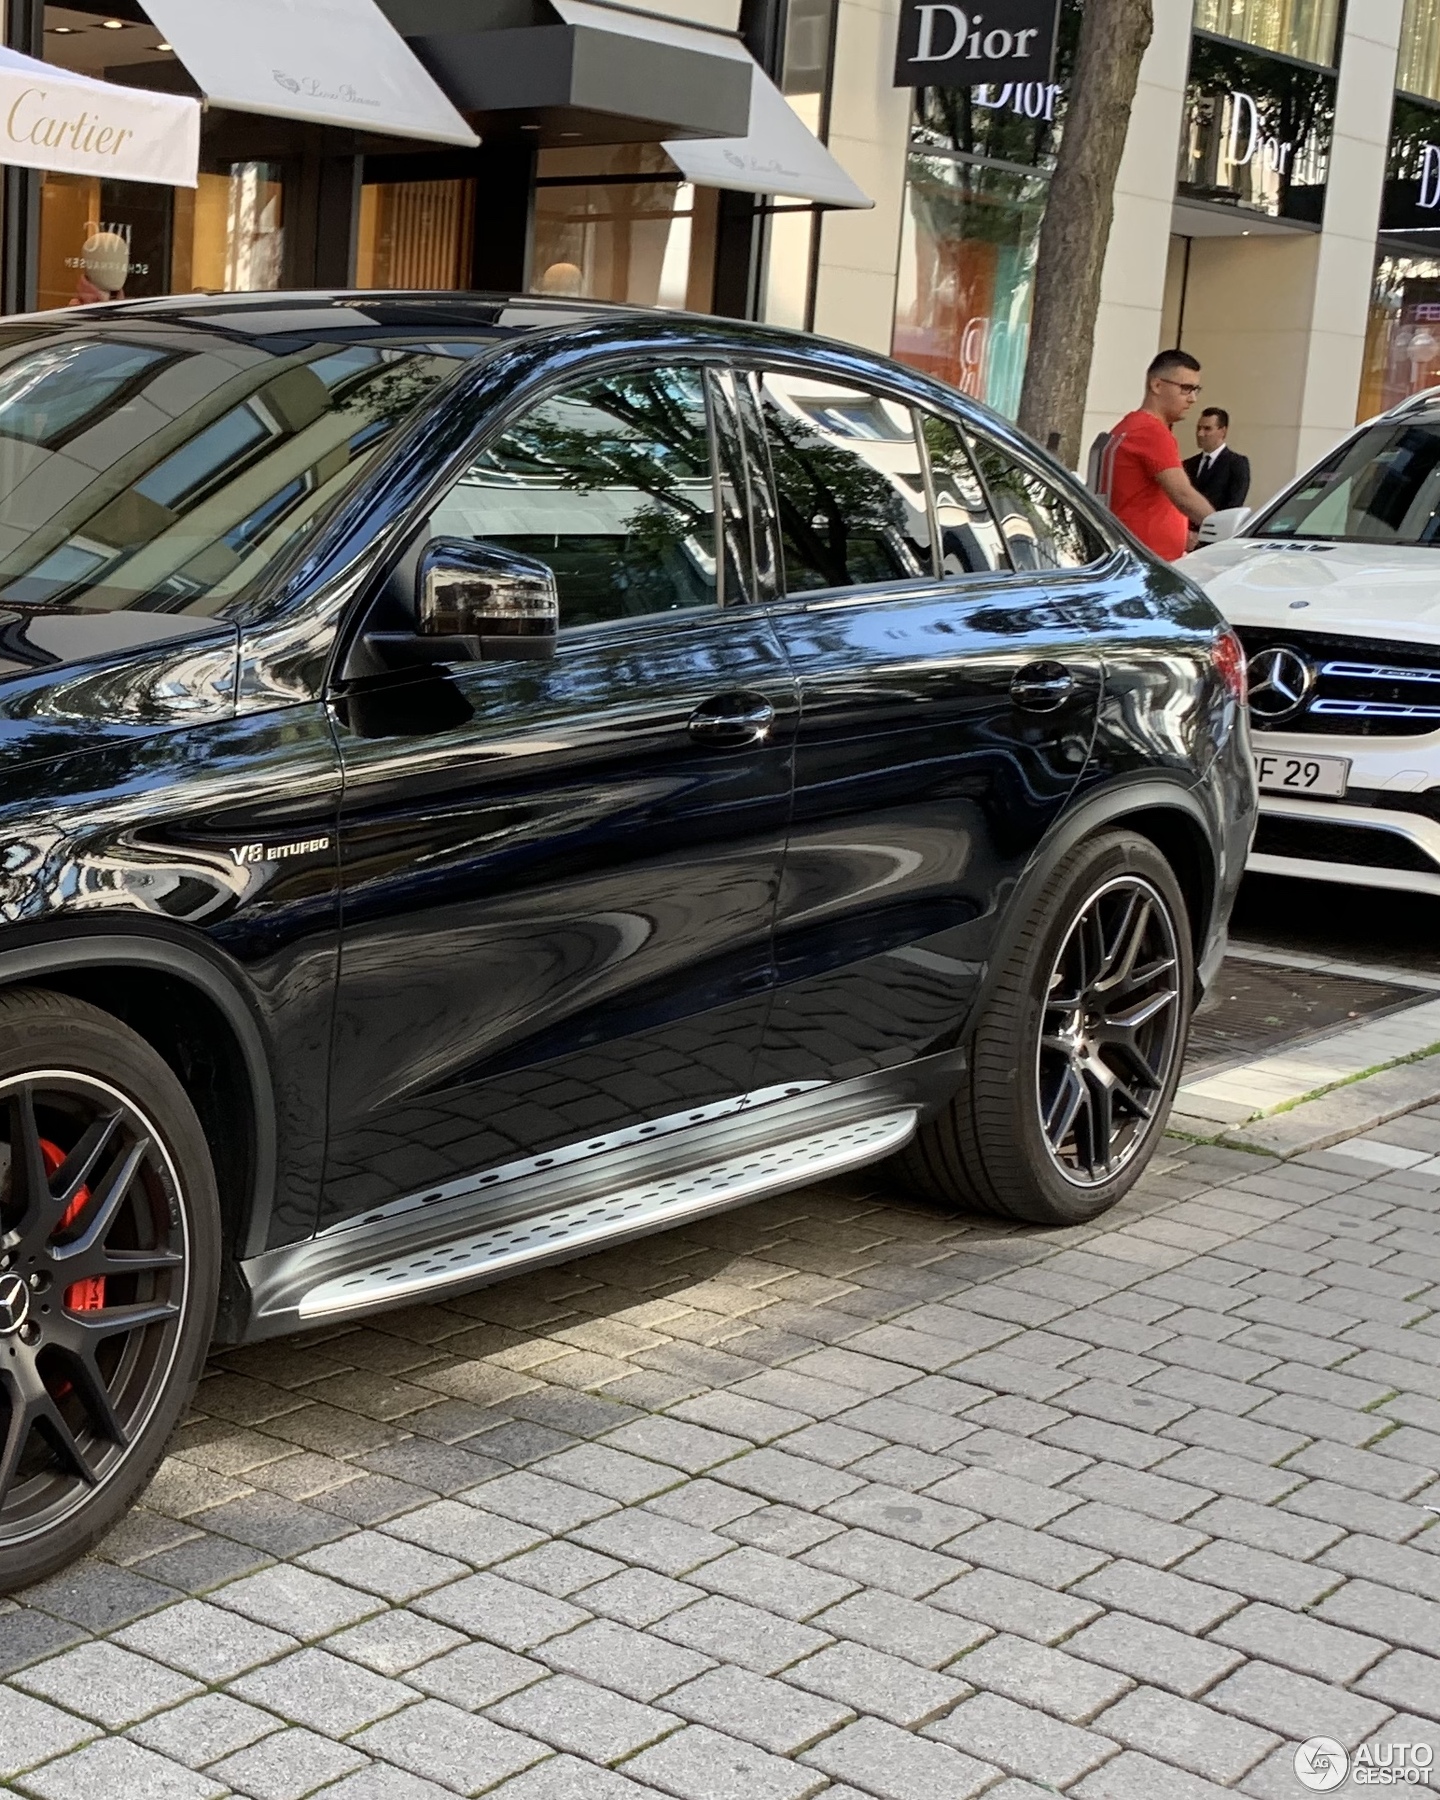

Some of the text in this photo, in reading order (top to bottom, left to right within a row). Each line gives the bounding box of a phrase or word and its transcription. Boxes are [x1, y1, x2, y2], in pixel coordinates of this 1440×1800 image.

[907, 4, 1039, 62] Dior
[7, 88, 133, 155] Cartier
[1223, 90, 1292, 176] Dior
[1283, 760, 1321, 788] 29
[229, 837, 329, 866] V8 BITURBO
